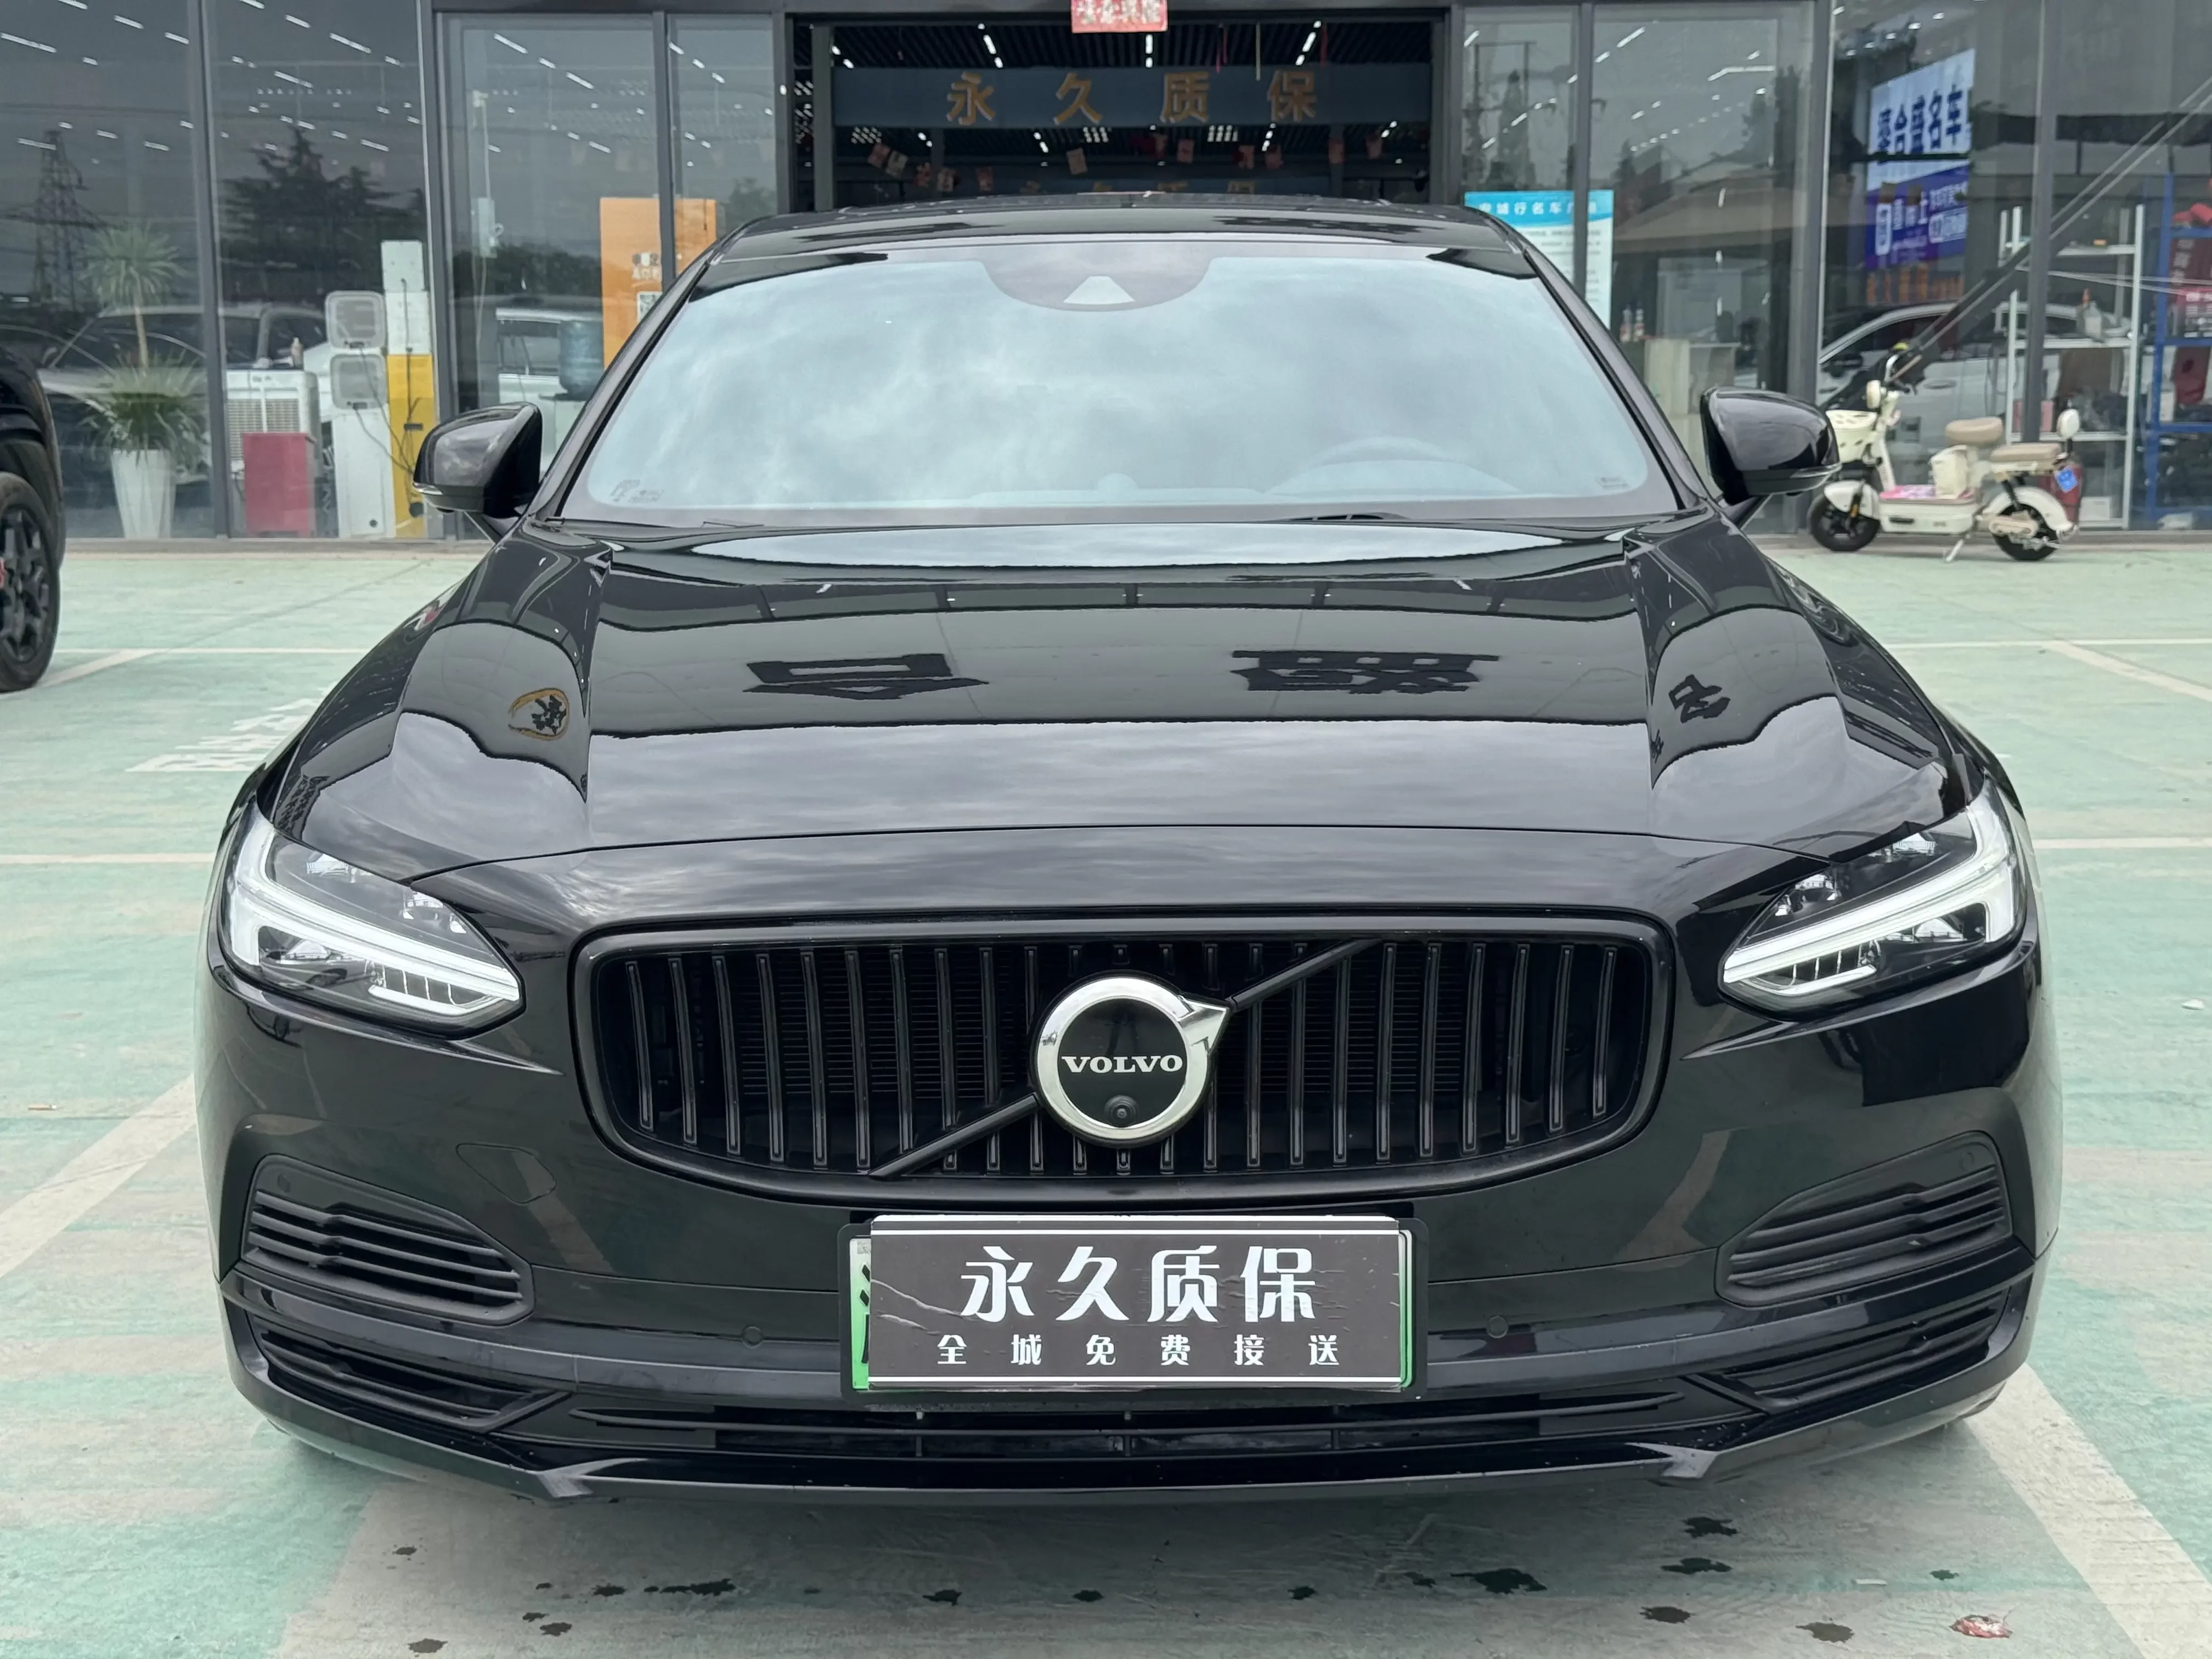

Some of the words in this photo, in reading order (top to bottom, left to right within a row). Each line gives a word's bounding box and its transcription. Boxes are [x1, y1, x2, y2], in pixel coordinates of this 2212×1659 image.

[946, 71, 1318, 125] 永久质保
[1062, 1054, 1183, 1073] VOLVO
[960, 1245, 1316, 1323] 永久质保
[937, 1334, 1340, 1365] 全城免费接送
